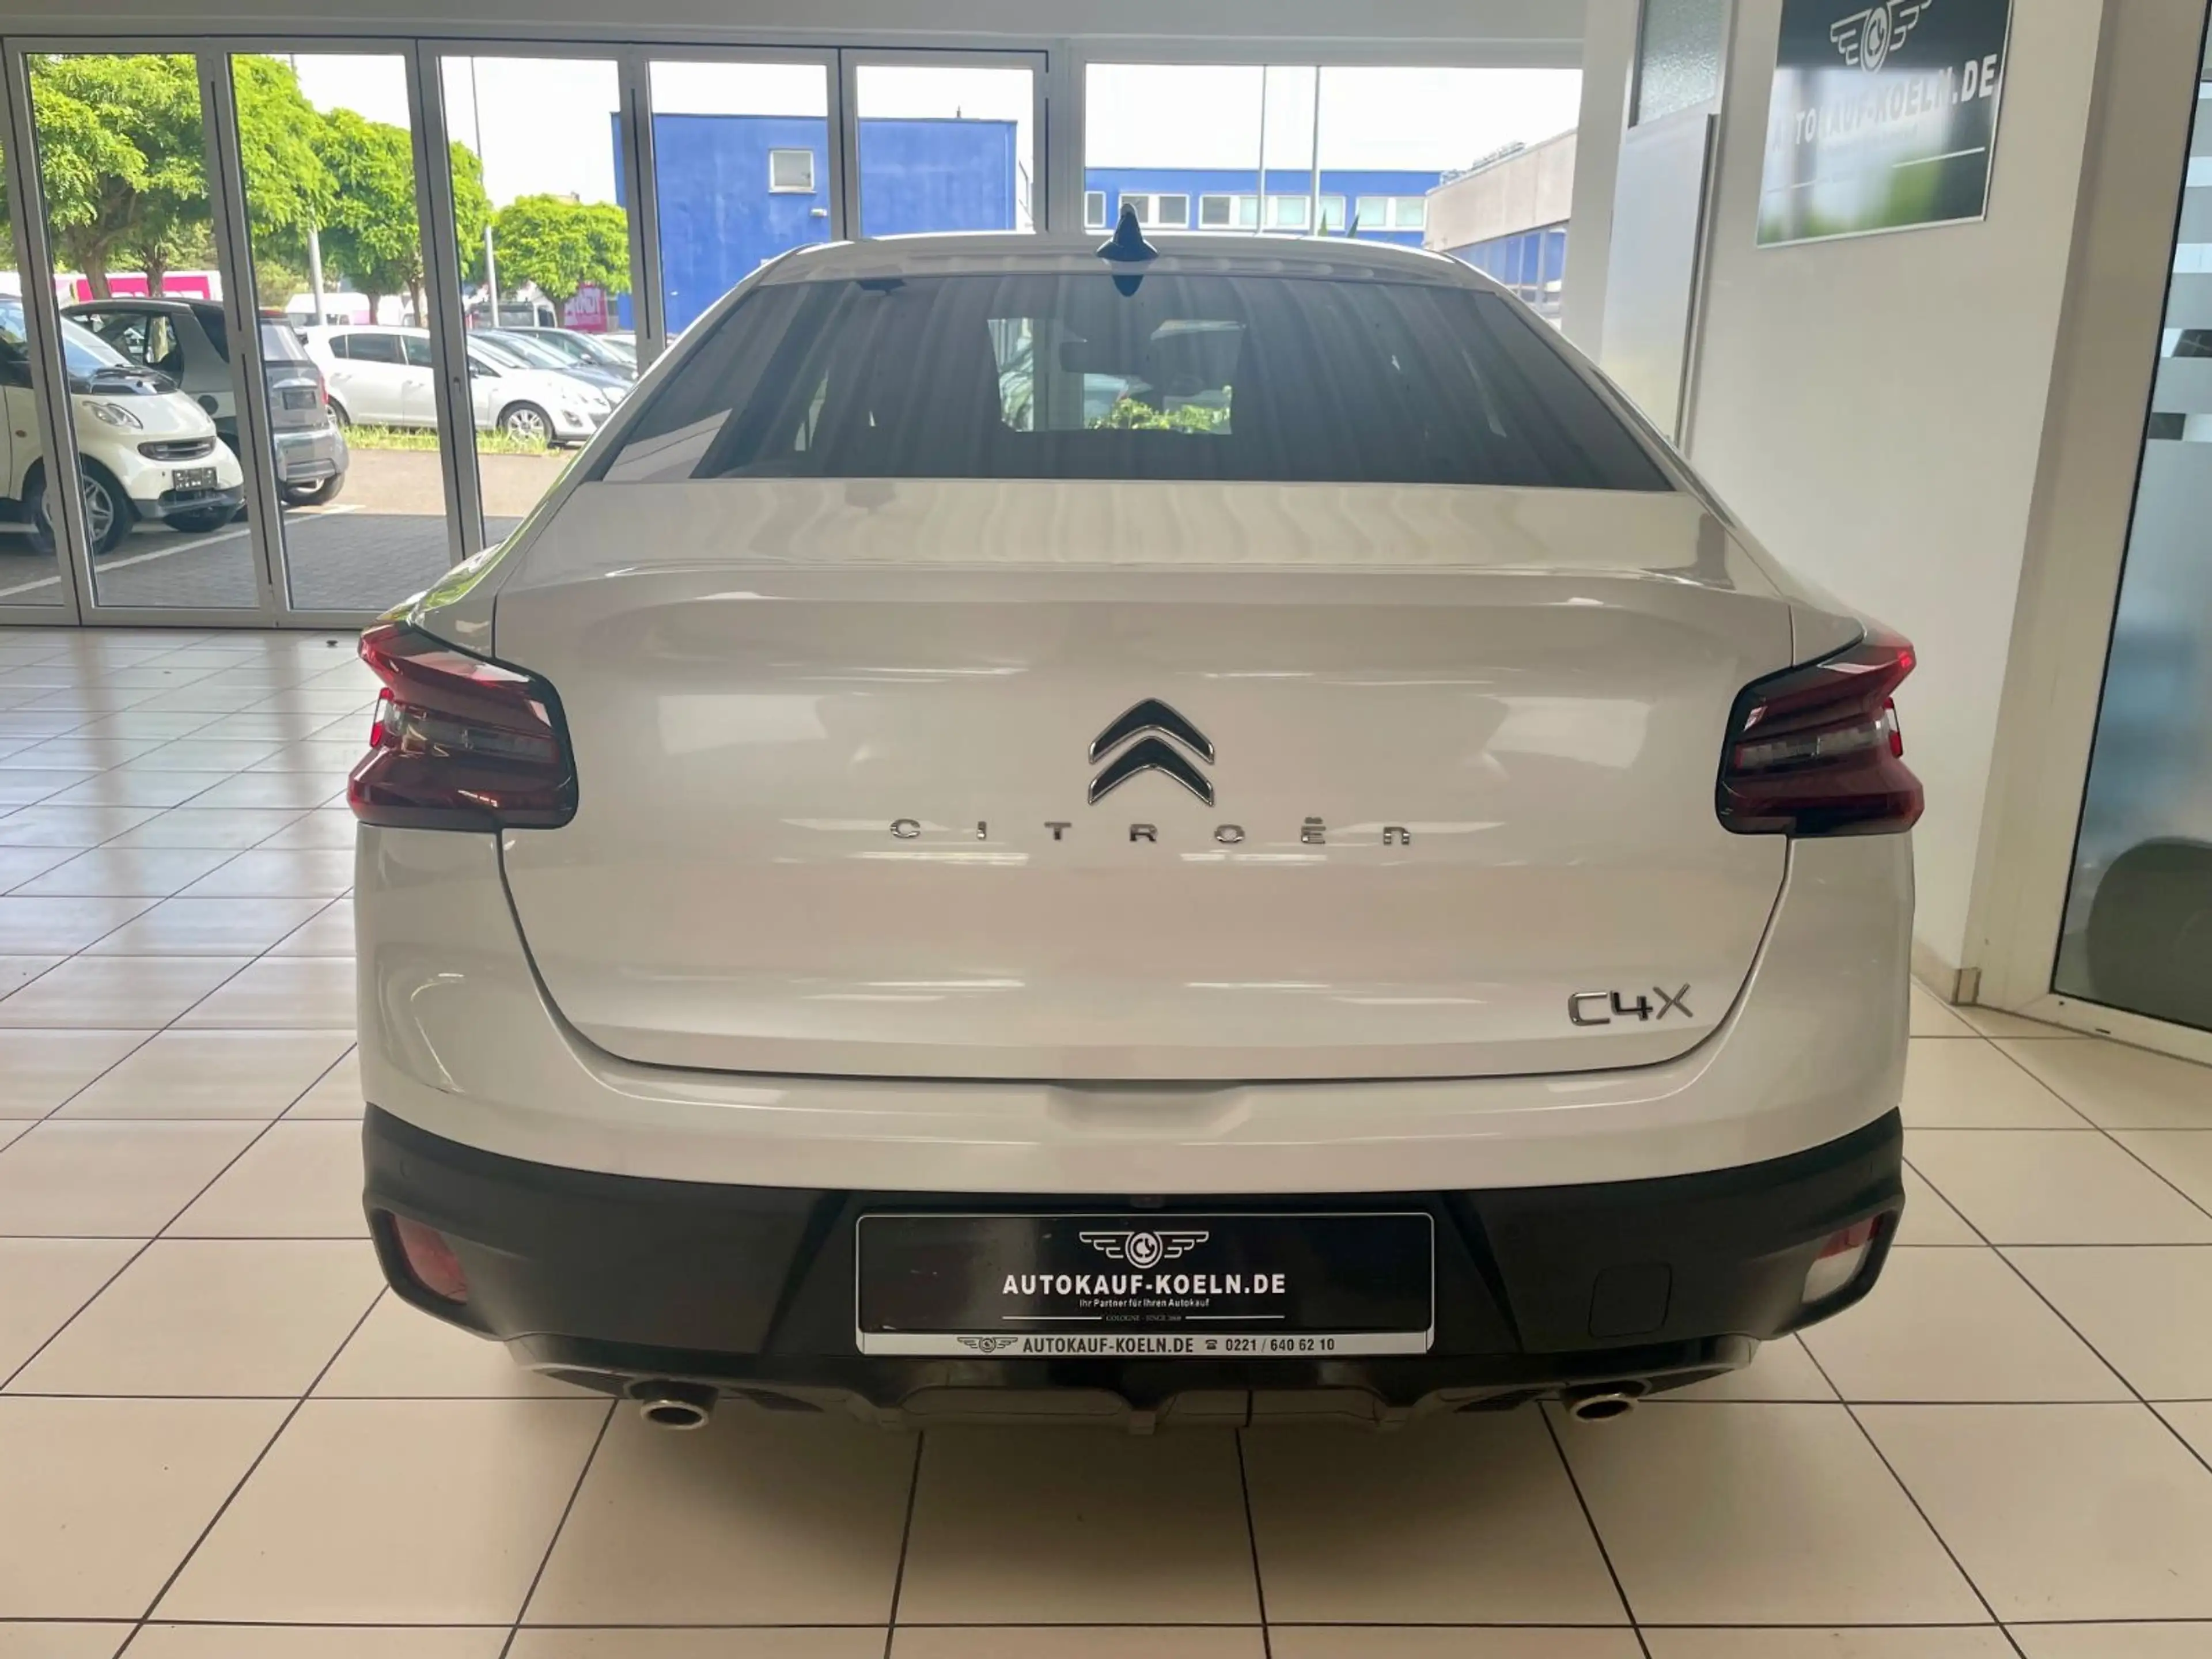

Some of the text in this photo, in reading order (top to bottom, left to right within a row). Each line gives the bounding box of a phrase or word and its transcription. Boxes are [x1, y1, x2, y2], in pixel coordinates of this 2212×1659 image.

[1772, 54, 1997, 152] TOAUF-KOELN.DE
[1002, 1274, 1286, 1295] AUTOKAUF-KOELN.DE
[1079, 1298, 1210, 1308] Ihr Partner für Ihren Autokauf
[1022, 1337, 1335, 1353] AUTOKAUF-KOELN.DE 0221 / 640 62 10
